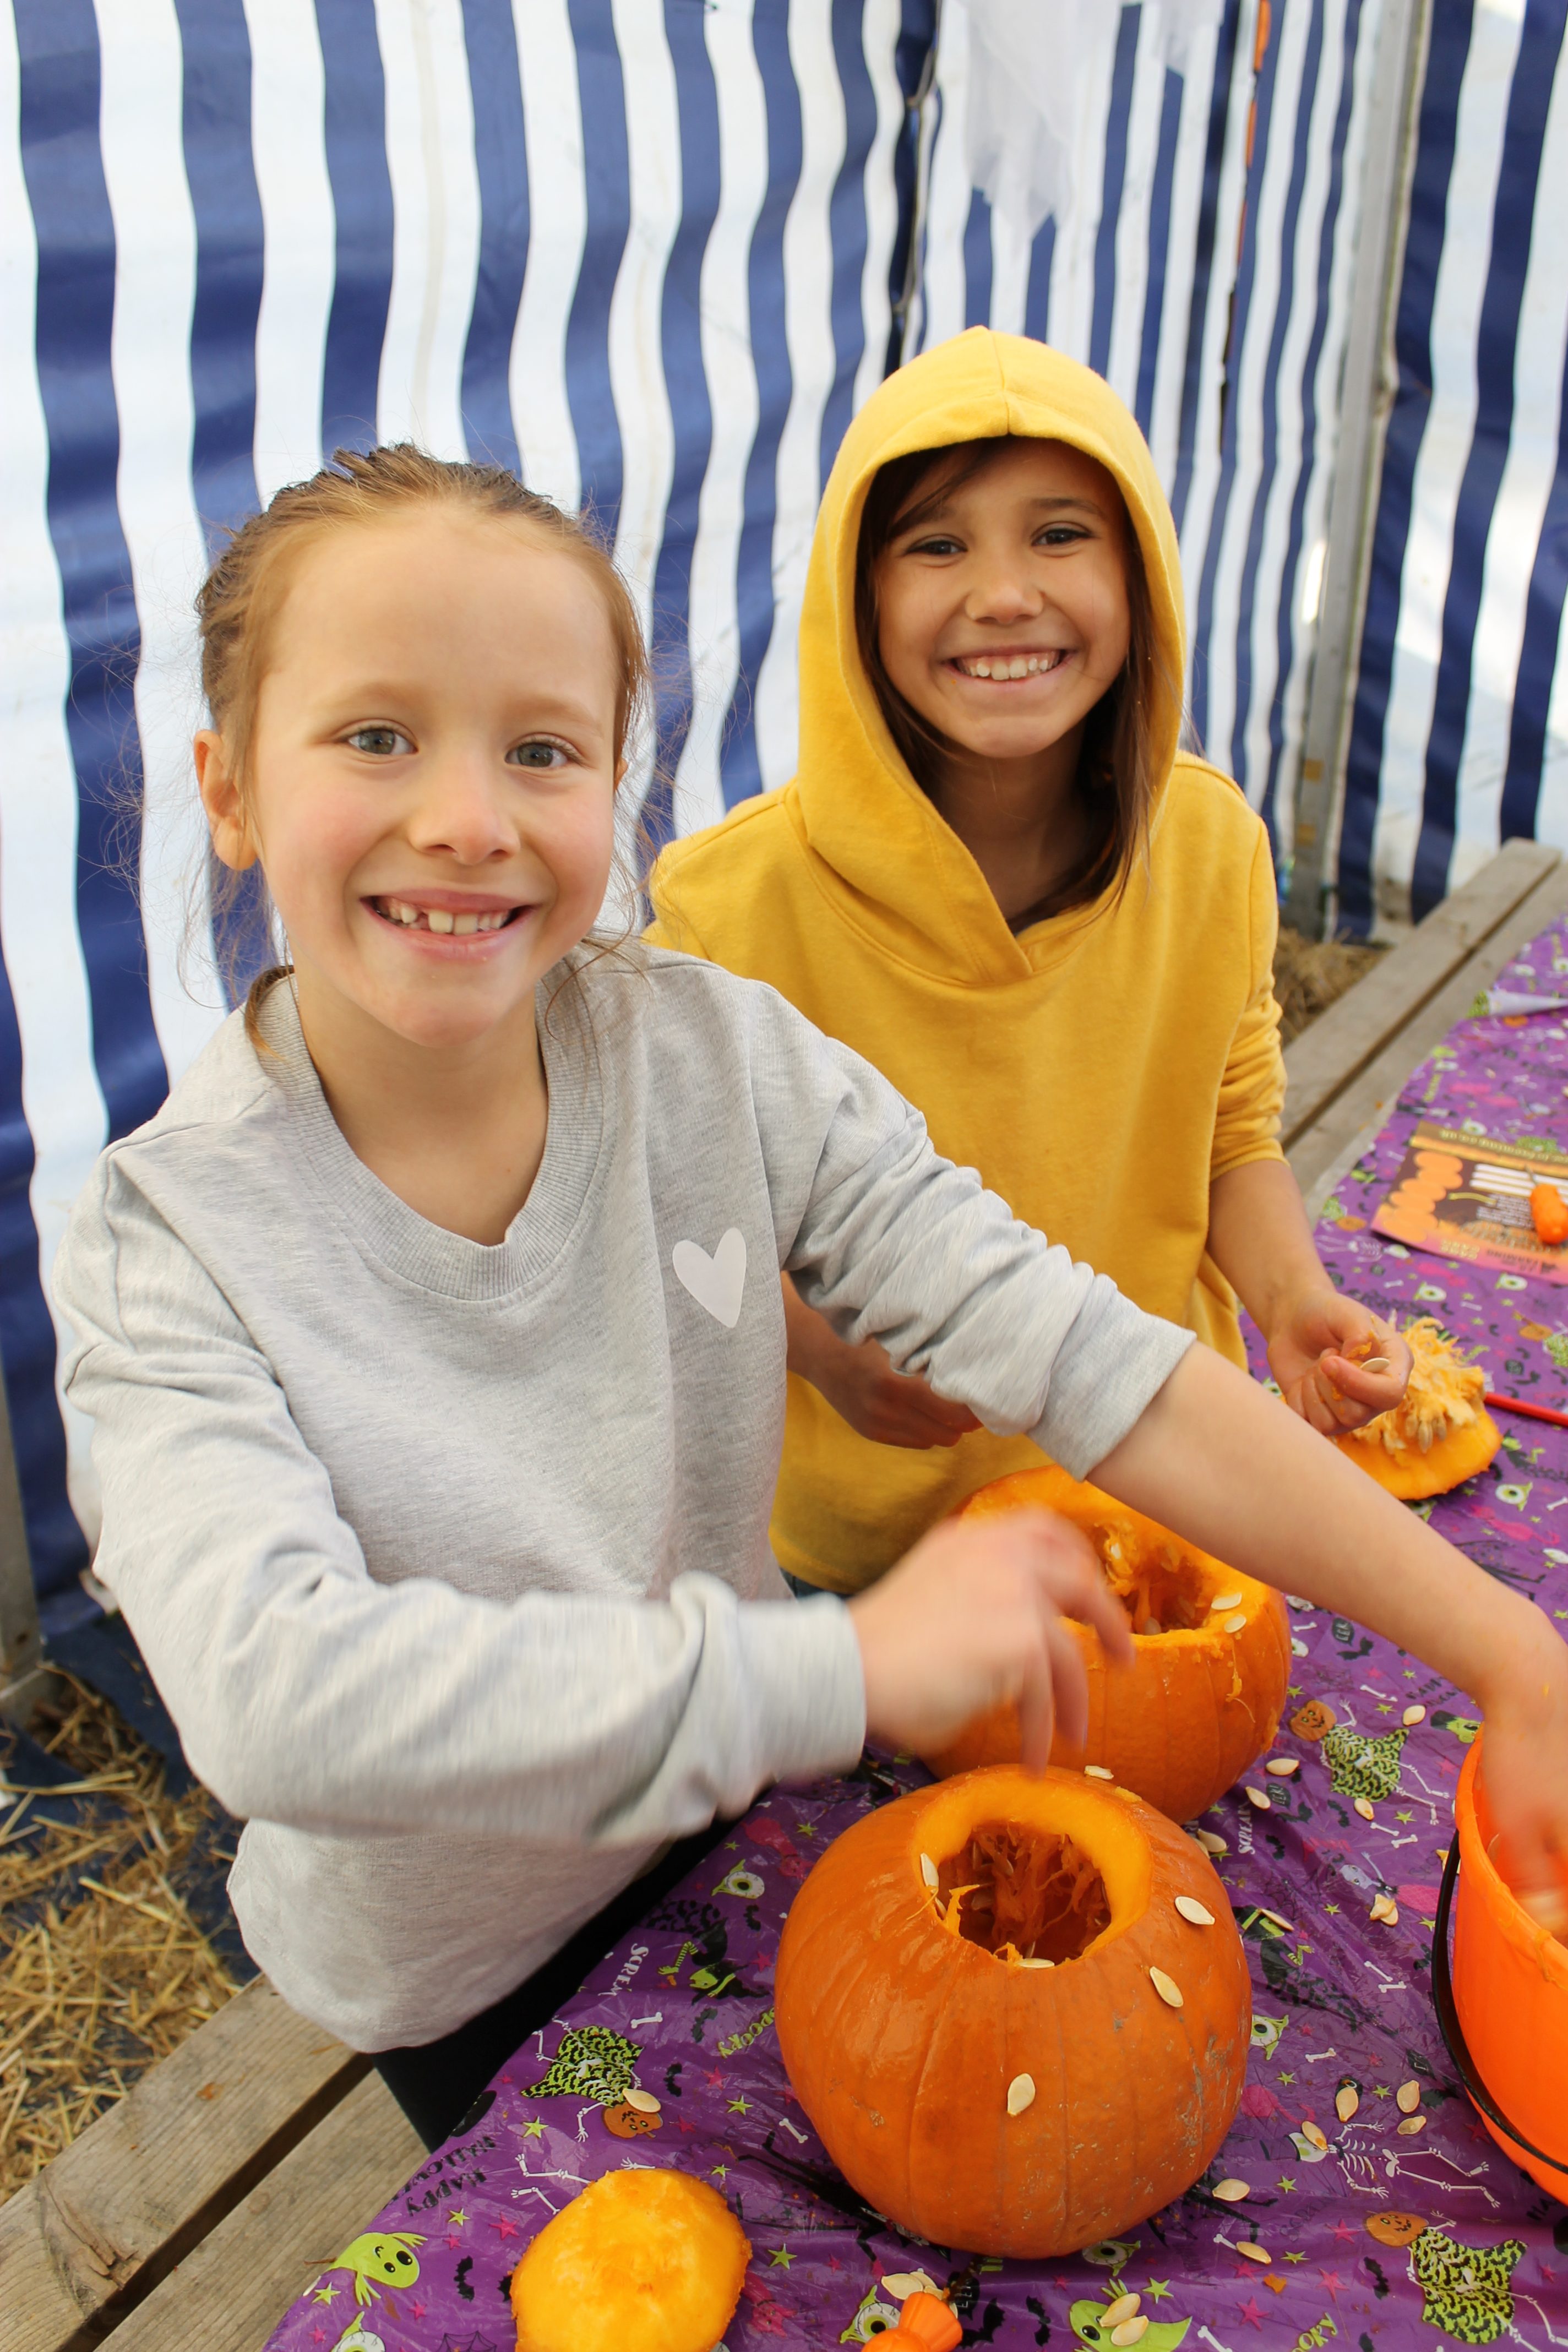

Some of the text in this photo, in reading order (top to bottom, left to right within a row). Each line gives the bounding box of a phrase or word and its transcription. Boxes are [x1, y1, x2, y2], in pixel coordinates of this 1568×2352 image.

[598, 1942, 649, 1997] SCREM
[382, 2135, 497, 2210] HALLOW
[406, 2167, 487, 2217] HAPPY
